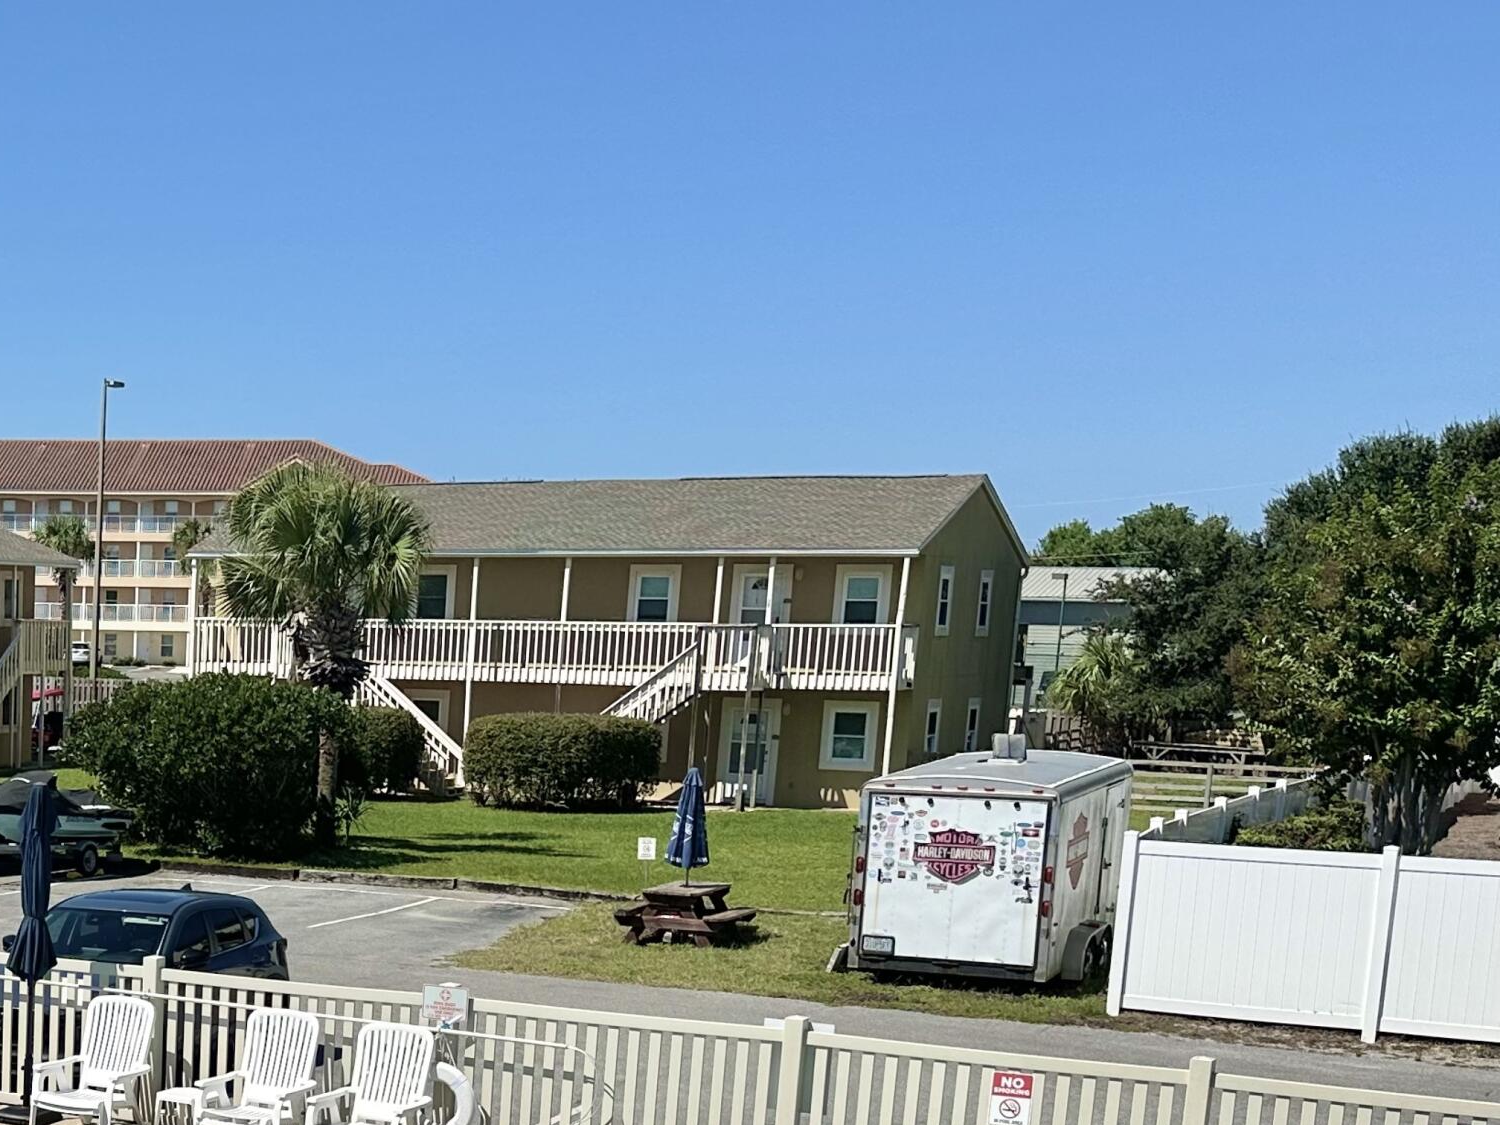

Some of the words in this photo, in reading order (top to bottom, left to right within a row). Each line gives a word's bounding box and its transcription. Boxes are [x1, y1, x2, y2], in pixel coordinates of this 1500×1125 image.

[935, 832, 975, 845] MOTOR
[917, 845, 991, 862] HARLEY-DAVIDSON
[933, 861, 972, 879] CYCLES
[1000, 1076, 1025, 1089] NO
[994, 1087, 1031, 1097] SMOKING
